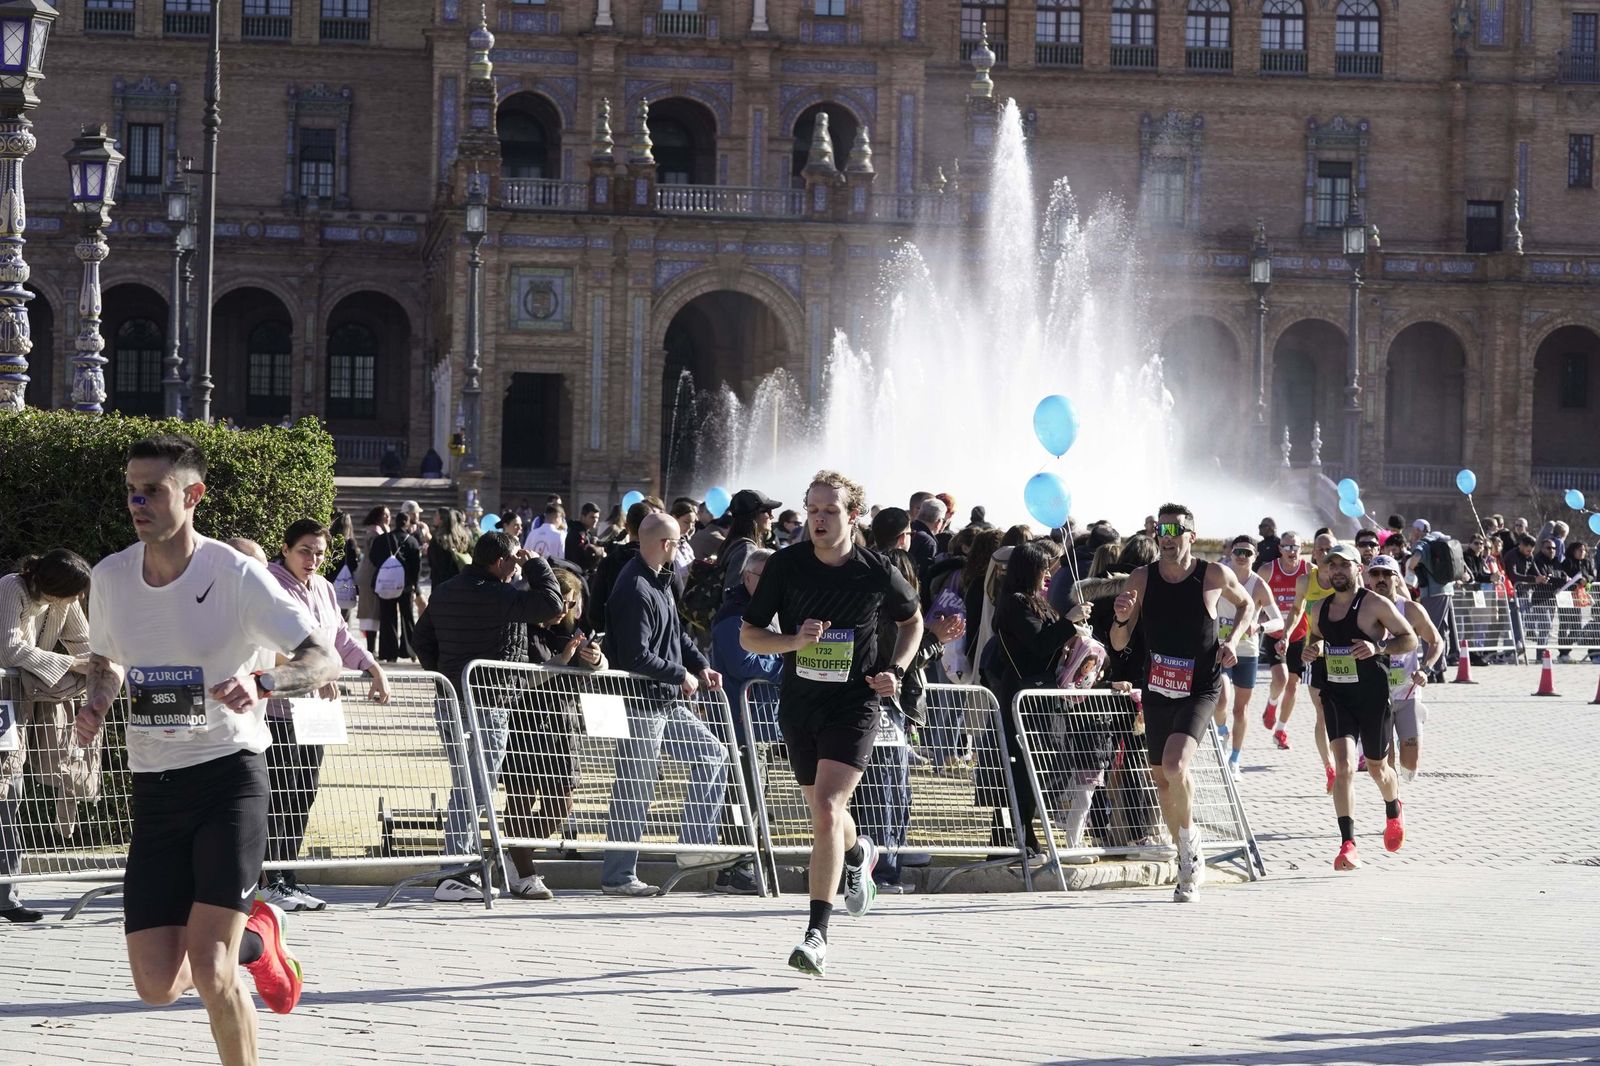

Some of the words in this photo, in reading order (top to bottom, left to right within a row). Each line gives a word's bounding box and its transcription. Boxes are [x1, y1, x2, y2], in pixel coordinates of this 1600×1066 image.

[820, 632, 848, 640] URICH
[815, 648, 833, 656] 1732
[1163, 657, 1189, 667] ZURICH
[147, 670, 193, 682] ZURICH
[1151, 674, 1164, 687] RUI
[1165, 678, 1188, 690] SILVA
[151, 692, 177, 705] 3853
[132, 713, 152, 725] DANI
[153, 713, 206, 726] GUARDADO
